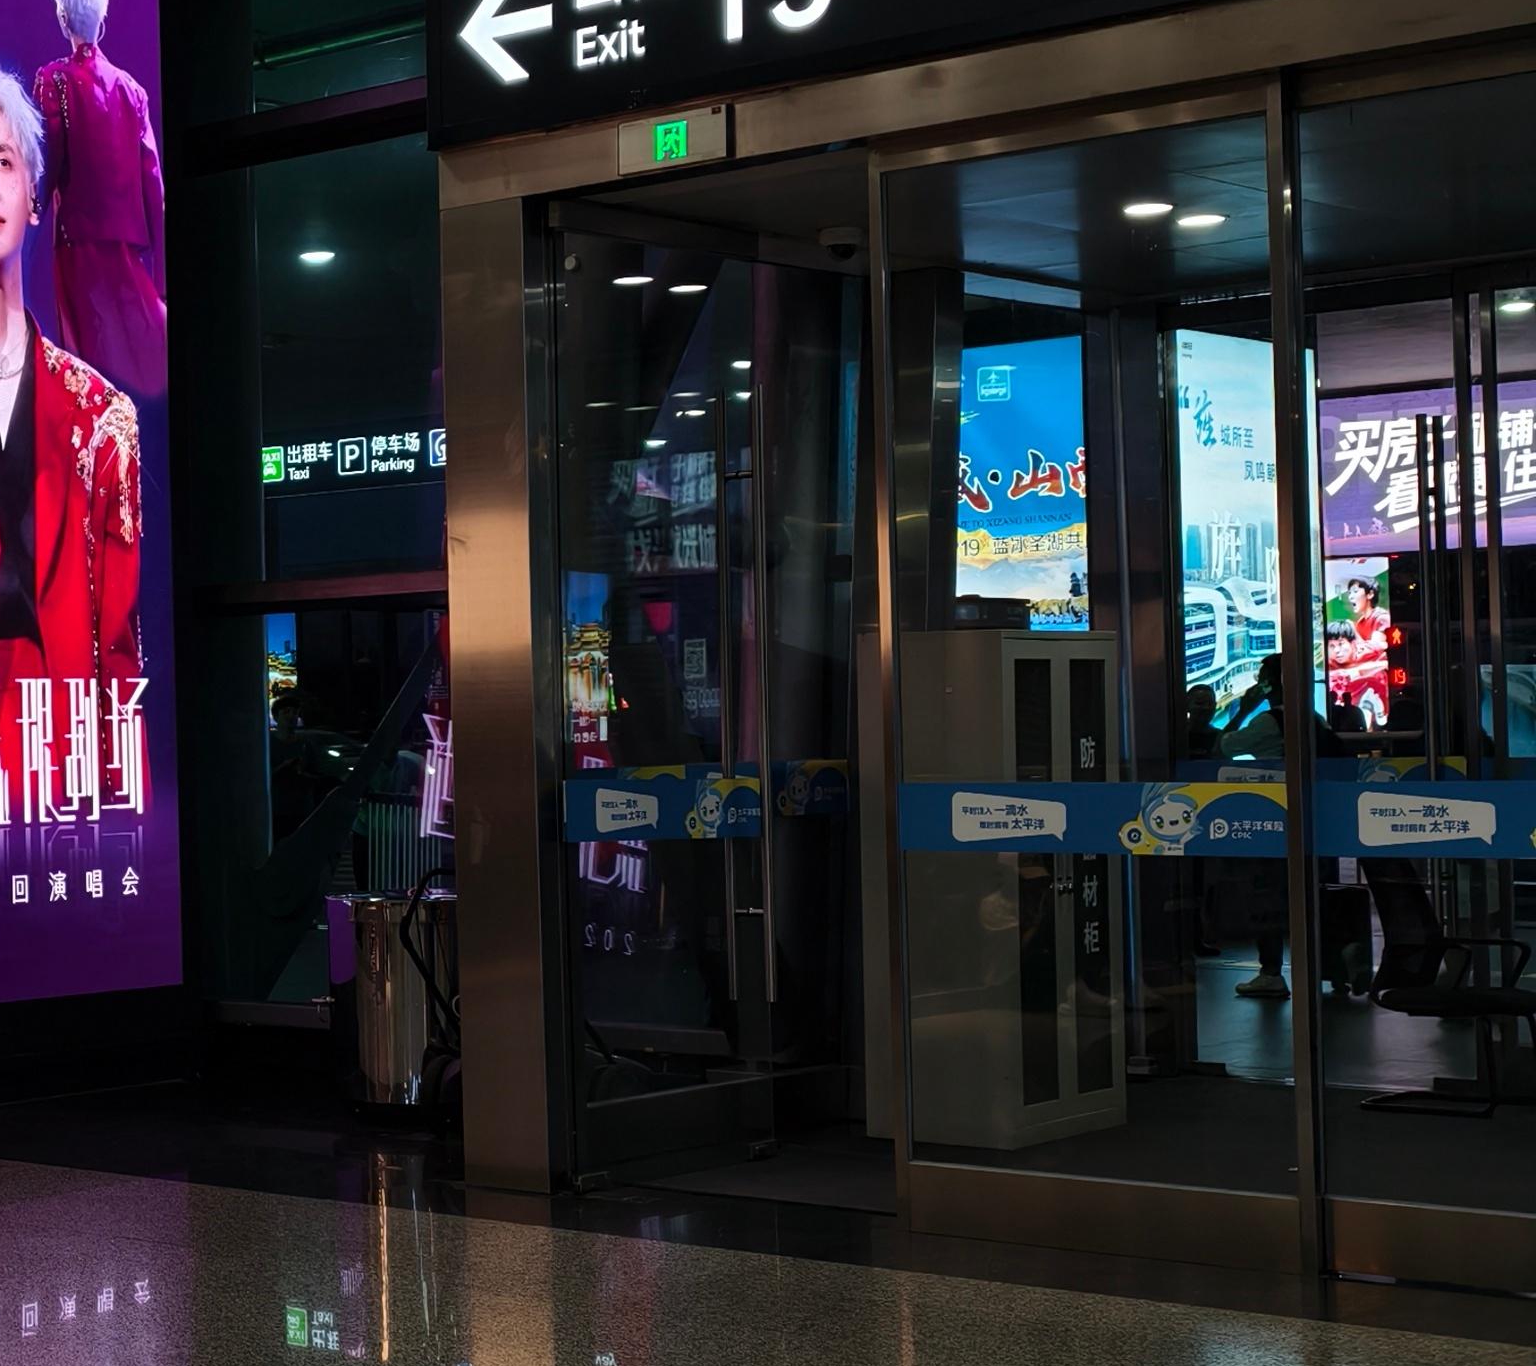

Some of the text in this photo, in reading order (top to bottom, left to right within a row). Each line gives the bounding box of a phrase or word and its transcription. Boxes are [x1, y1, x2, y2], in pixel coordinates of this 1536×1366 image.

[574, 19, 646, 69] Exit
[287, 441, 333, 464] 出租车
[371, 432, 420, 456] 停车场
[287, 466, 310, 481] Taxi
[371, 458, 415, 473] Parking
[1231, 821, 1284, 832] 太平洋保险
[1080, 736, 1100, 954] 防材柜
